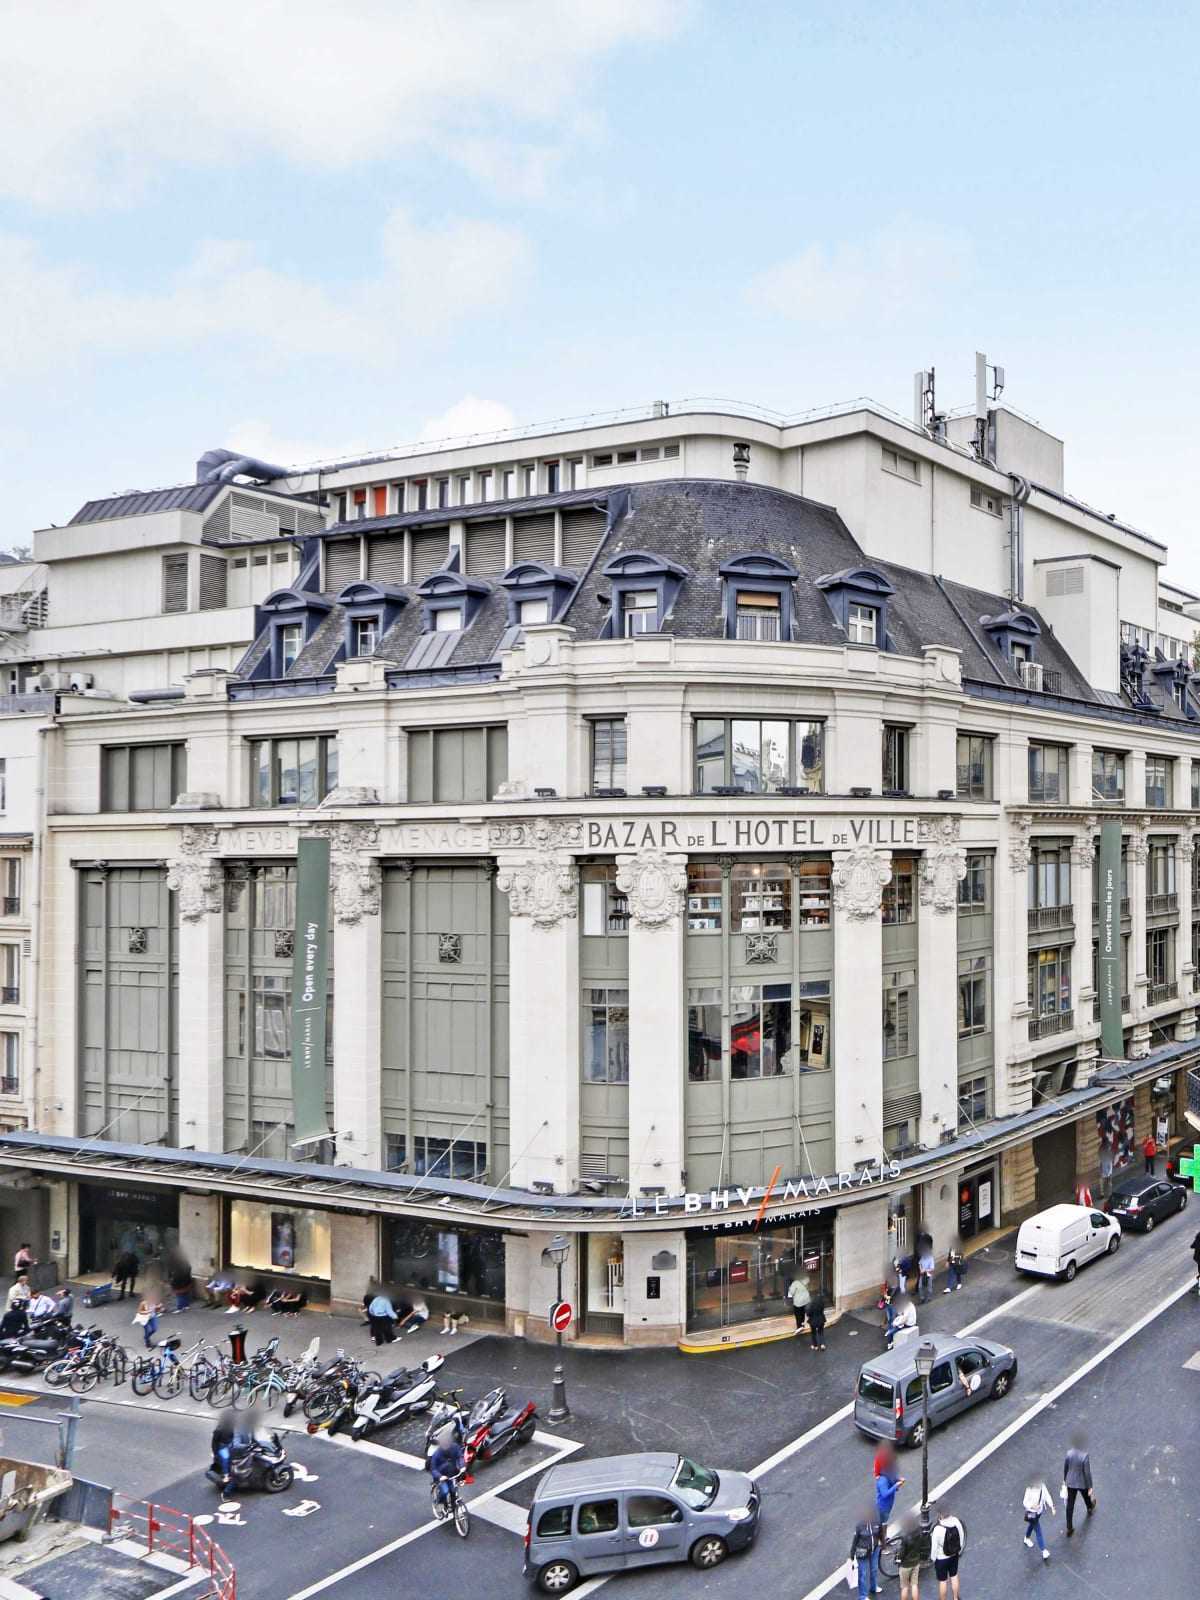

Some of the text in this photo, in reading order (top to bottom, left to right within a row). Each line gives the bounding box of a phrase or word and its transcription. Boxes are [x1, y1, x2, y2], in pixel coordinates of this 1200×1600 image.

[587, 819, 915, 848] BAZAR DE L'HOTEL DE VILLE
[302, 922, 319, 1002] Open every day
[632, 1160, 901, 1217] LE BHV MARAIS
